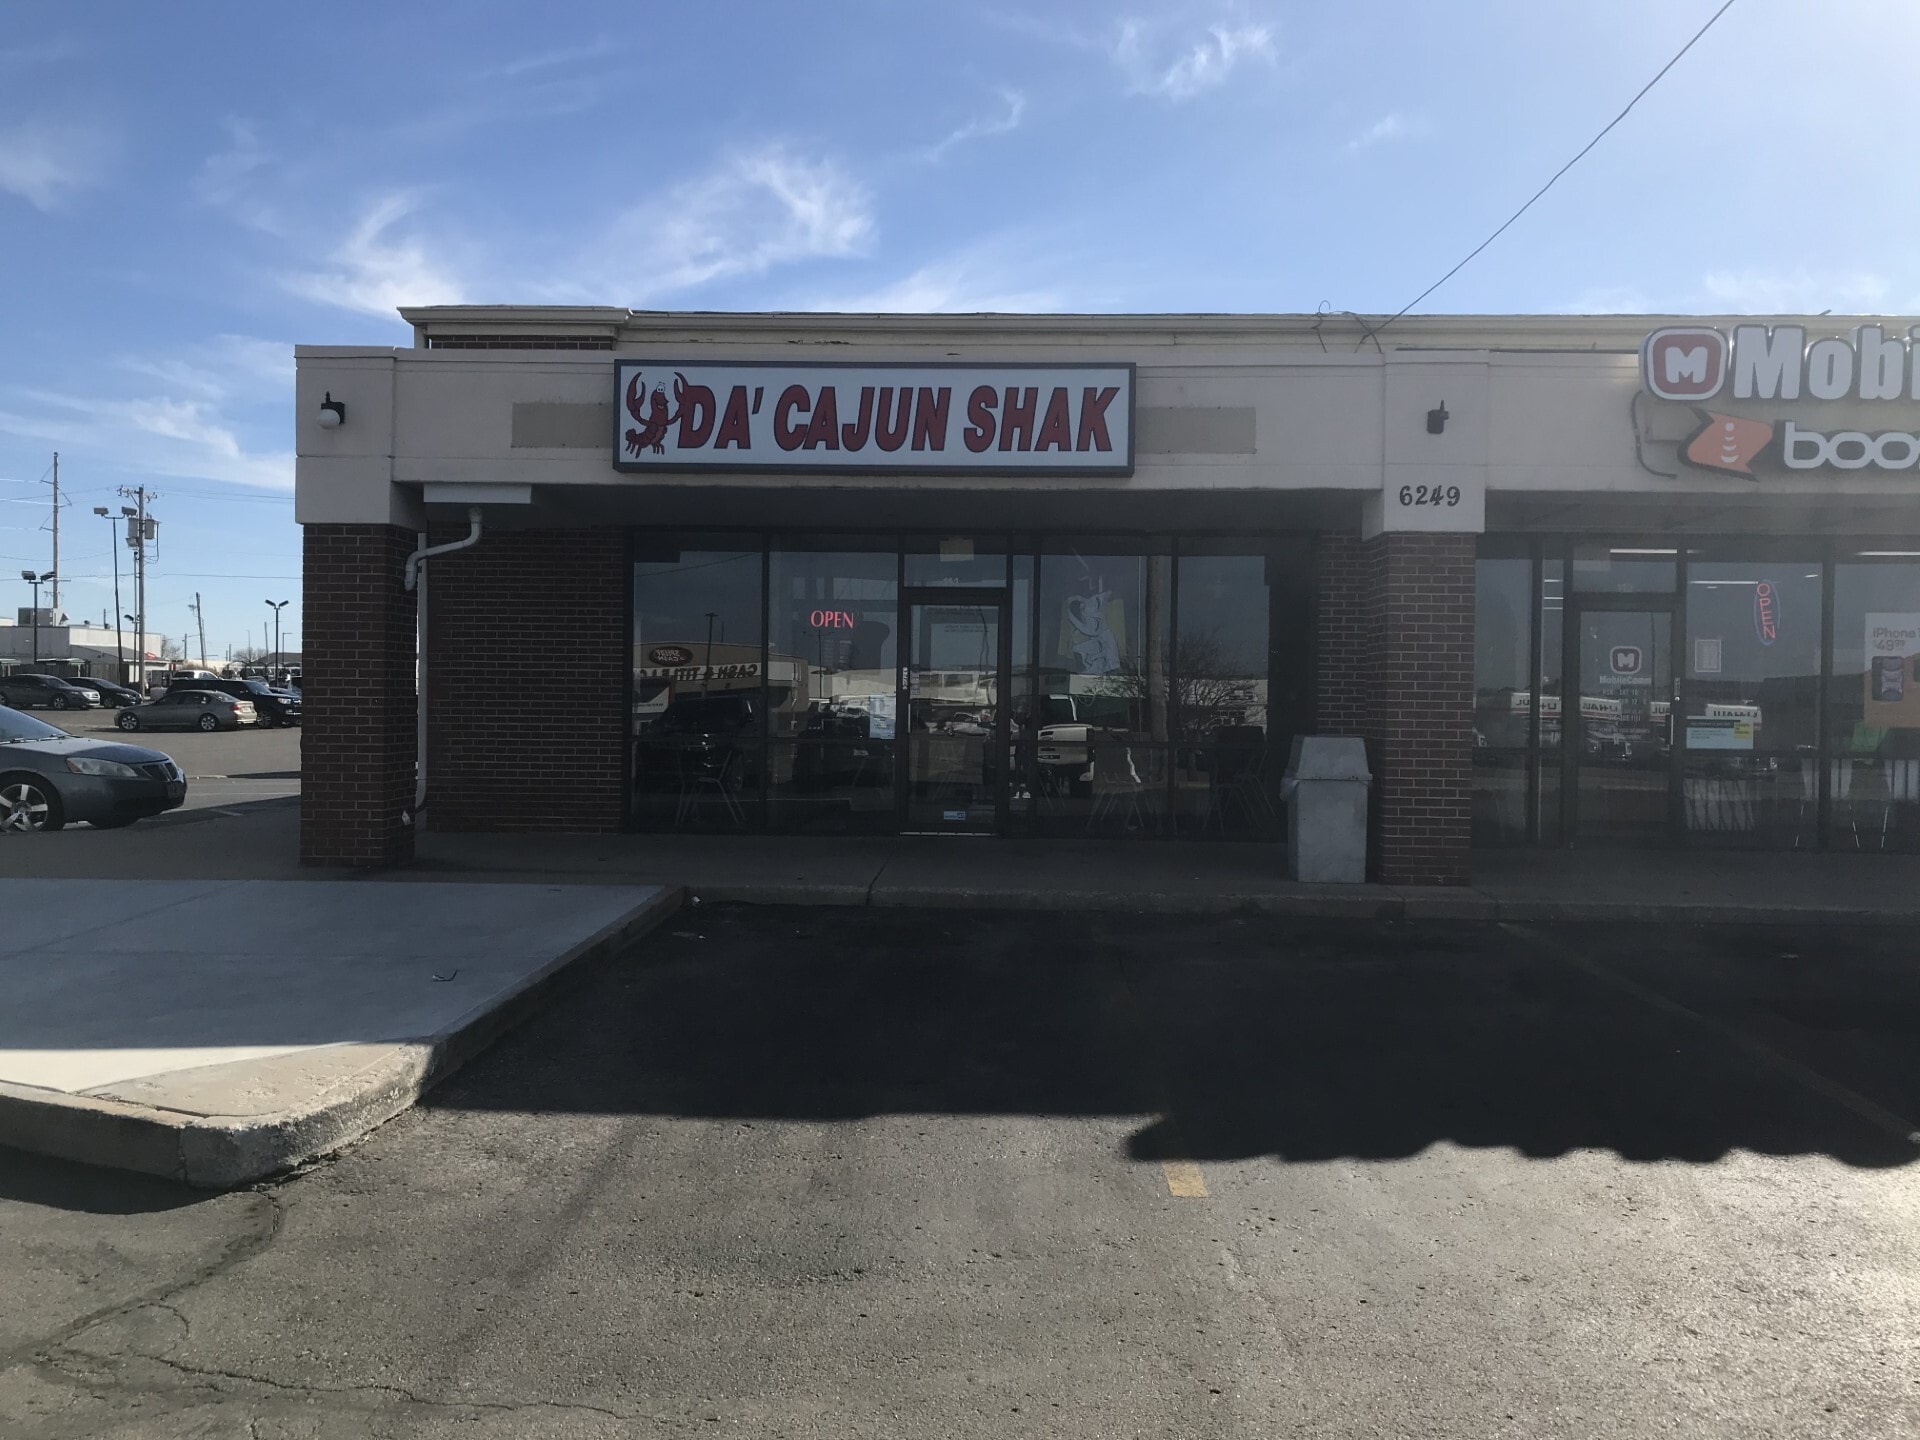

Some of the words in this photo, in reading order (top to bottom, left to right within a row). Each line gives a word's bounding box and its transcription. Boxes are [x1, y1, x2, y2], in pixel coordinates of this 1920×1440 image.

[677, 385, 764, 450] DA'
[773, 384, 952, 453] CAJUN
[963, 385, 1121, 453] SHAK
[1784, 421, 1920, 470] boo
[1399, 484, 1461, 507] 6249
[810, 610, 855, 629] OPEN
[1756, 583, 1776, 640] OPEN
[1873, 627, 1916, 639] iPhone
